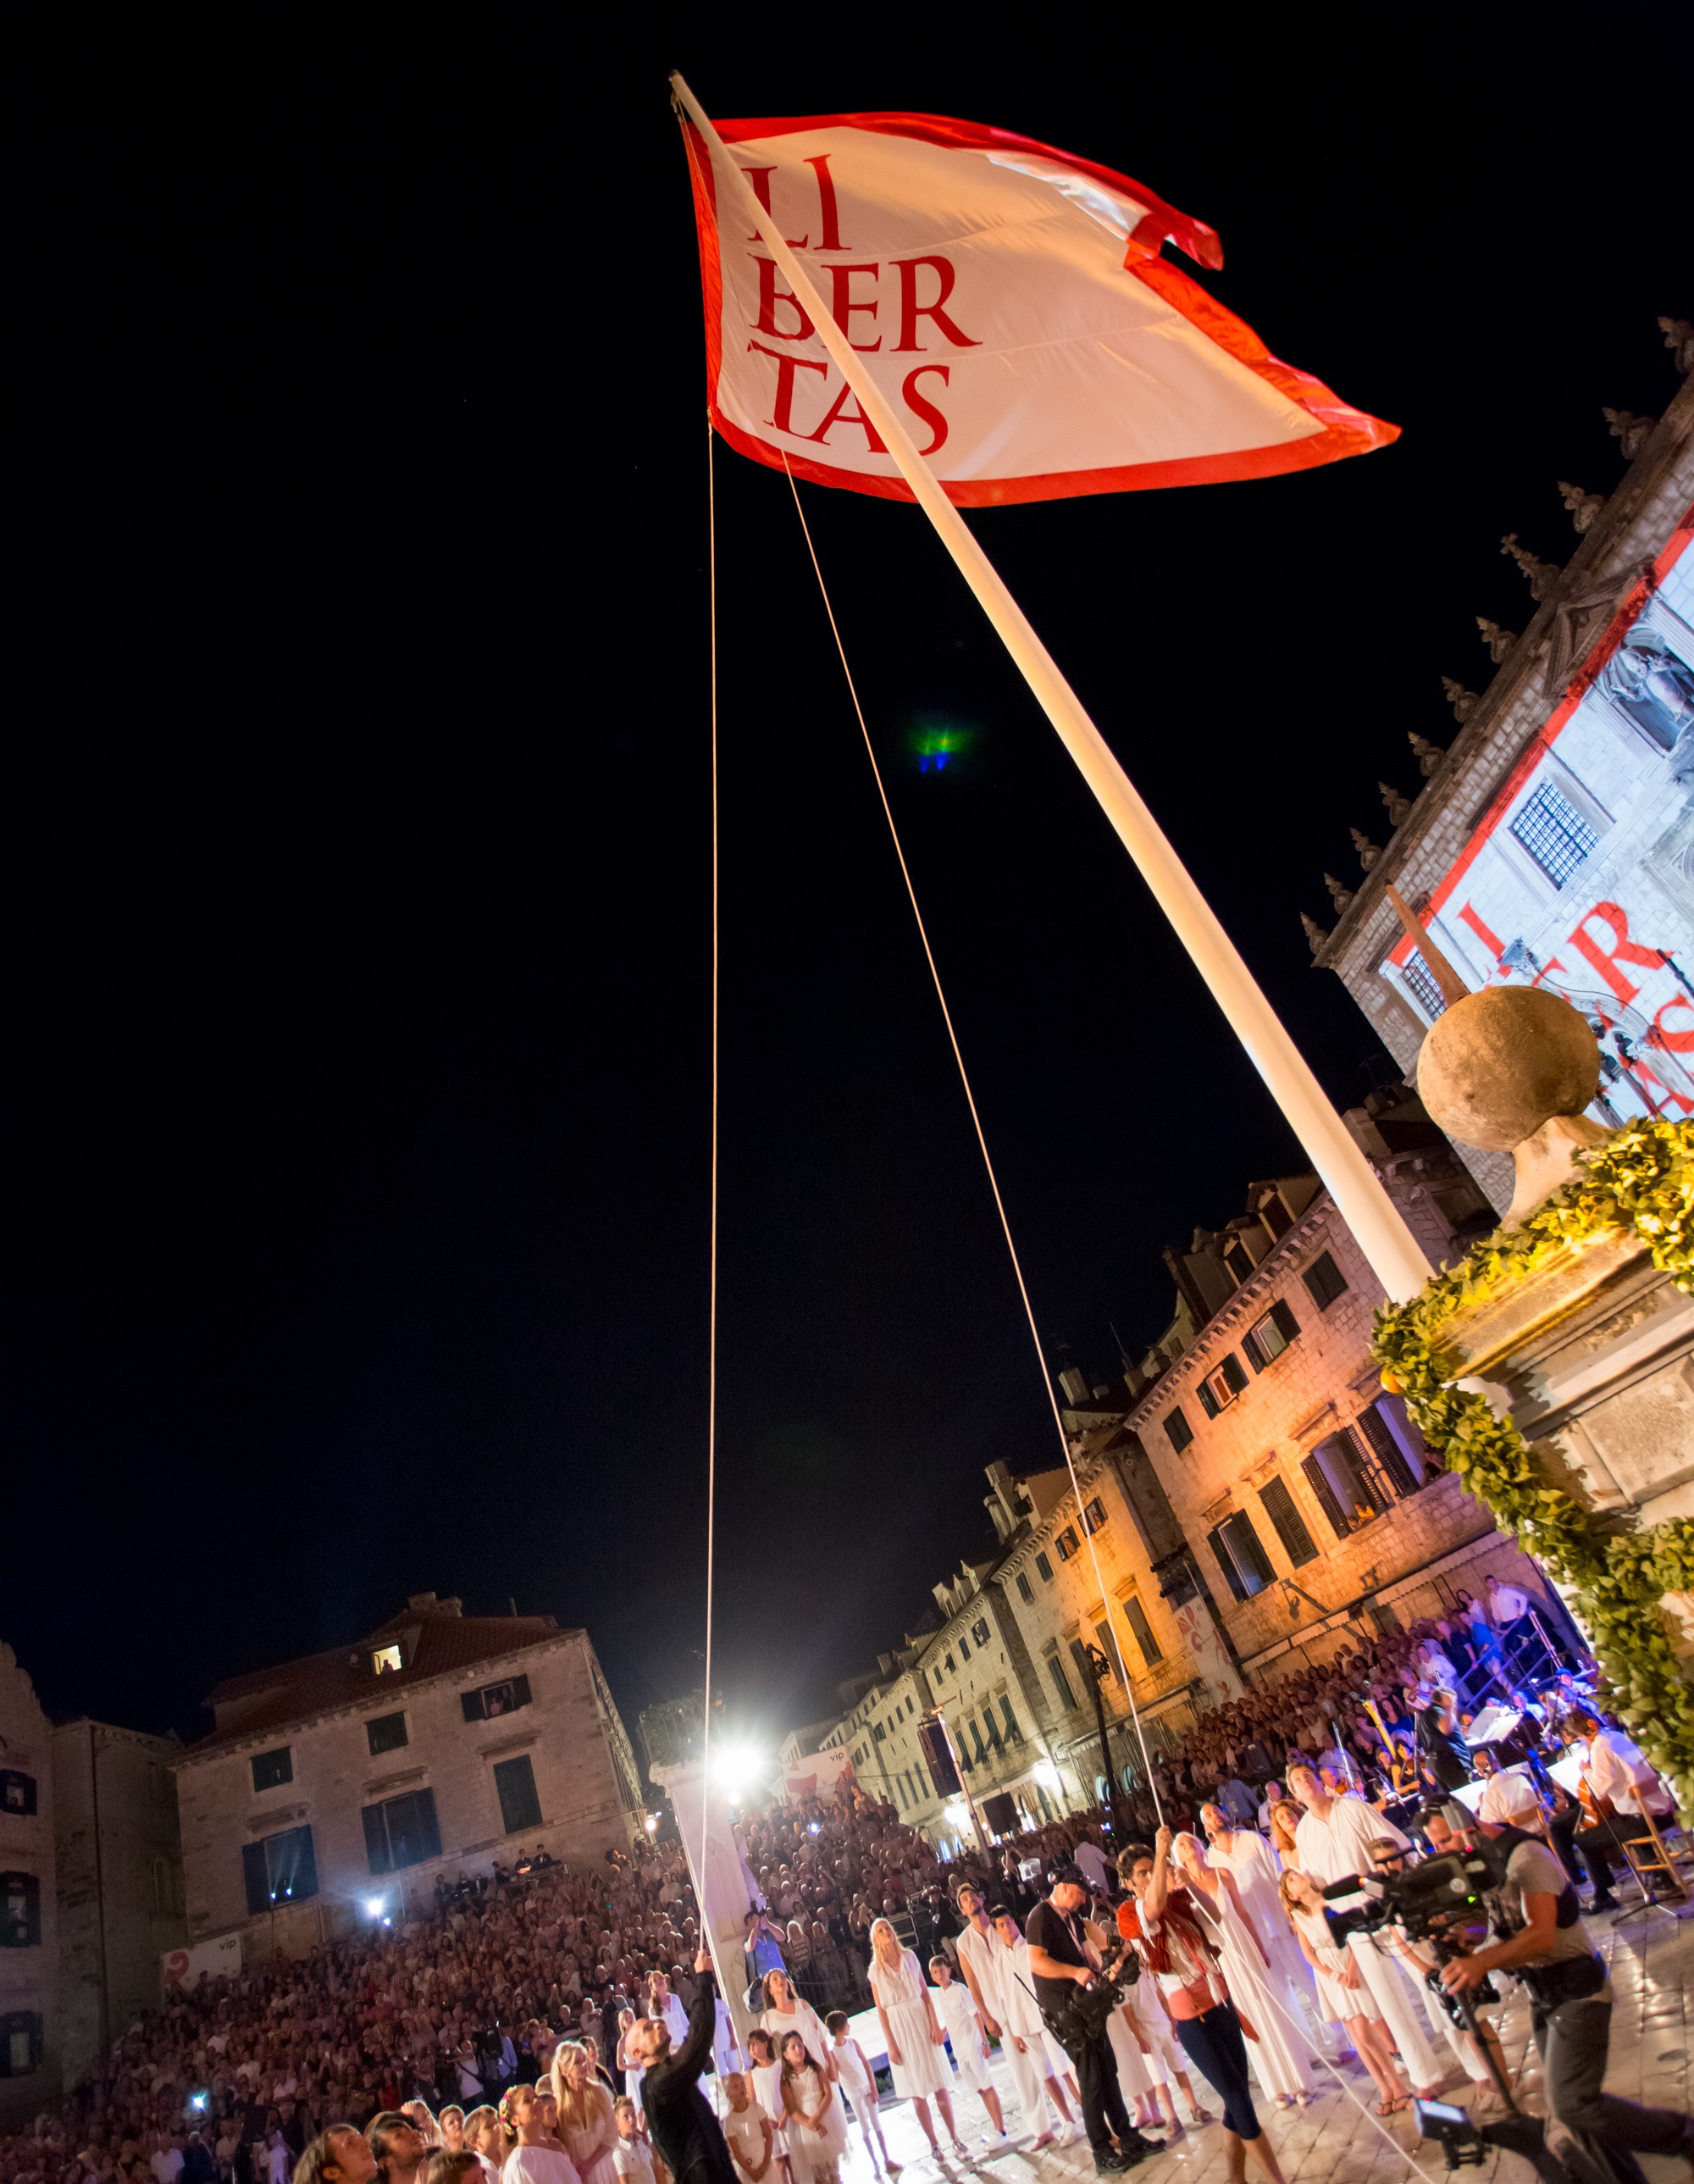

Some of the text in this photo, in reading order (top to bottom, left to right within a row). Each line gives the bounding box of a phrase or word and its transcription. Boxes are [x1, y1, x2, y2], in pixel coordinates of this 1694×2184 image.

[740, 153, 852, 251] LI
[746, 252, 983, 353] BER
[746, 339, 950, 457] TAS
[829, 1751, 844, 1761] vip
[219, 1938, 236, 1950] vip
